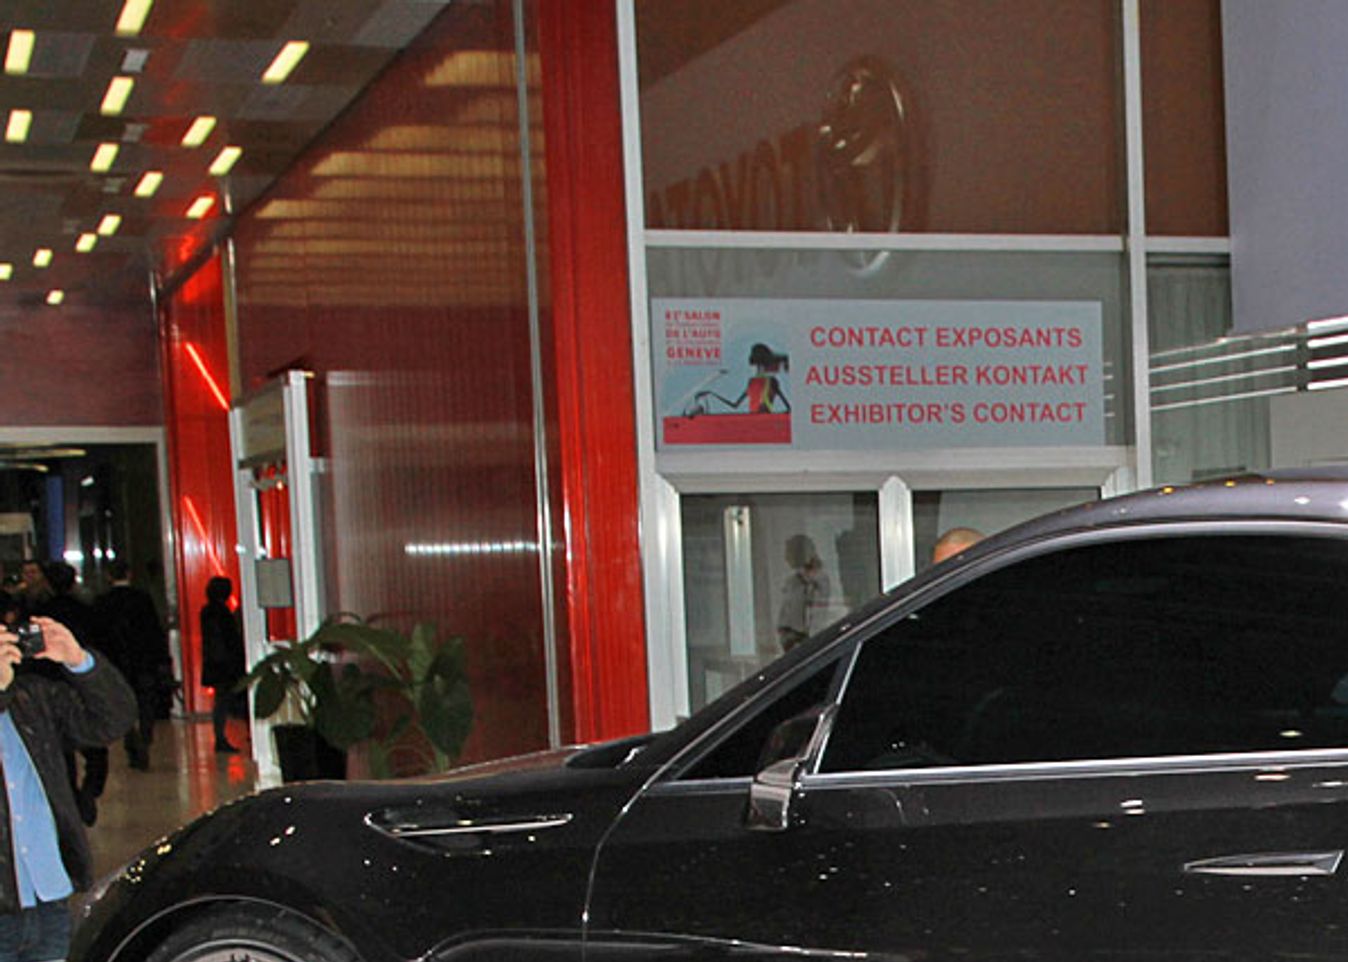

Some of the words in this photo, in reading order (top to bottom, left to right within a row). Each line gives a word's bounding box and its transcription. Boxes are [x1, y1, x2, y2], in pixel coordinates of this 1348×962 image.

[809, 326, 928, 348] CONTACT
[934, 326, 1083, 348] EXPOSANTS
[805, 364, 969, 386] AUSSTELLER
[974, 364, 1088, 385] KONTAKT
[809, 402, 966, 424] EXHIBITOR'S
[972, 401, 1087, 423] CONTACT
